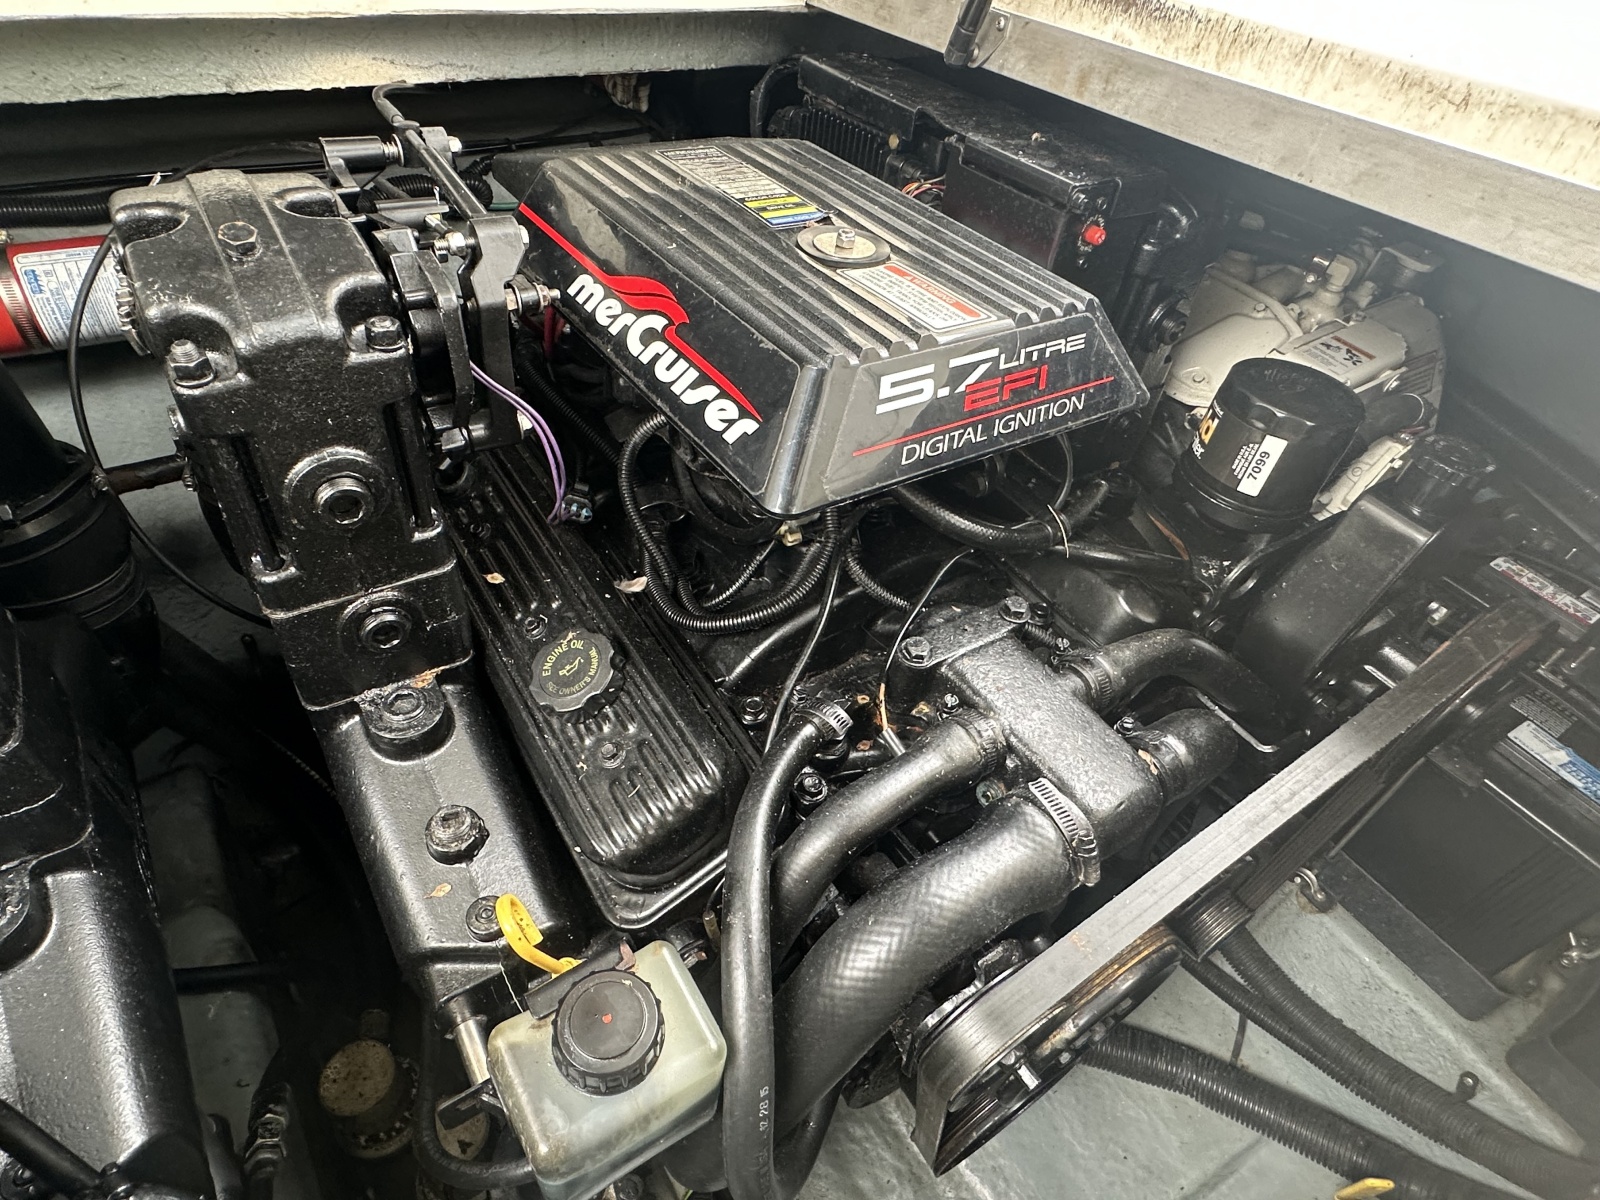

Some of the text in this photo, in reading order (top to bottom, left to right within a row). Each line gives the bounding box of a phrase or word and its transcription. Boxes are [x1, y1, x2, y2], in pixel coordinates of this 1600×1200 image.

[876, 333, 1087, 415] 5.7 LITRE
[964, 365, 1048, 412] EFI
[900, 393, 1085, 466] DIGITAL IGNITION
[1247, 451, 1271, 481] 7099
[542, 639, 585, 677] ENGINE OIL
[546, 646, 599, 695] SEE OWNER'S MANUAL
